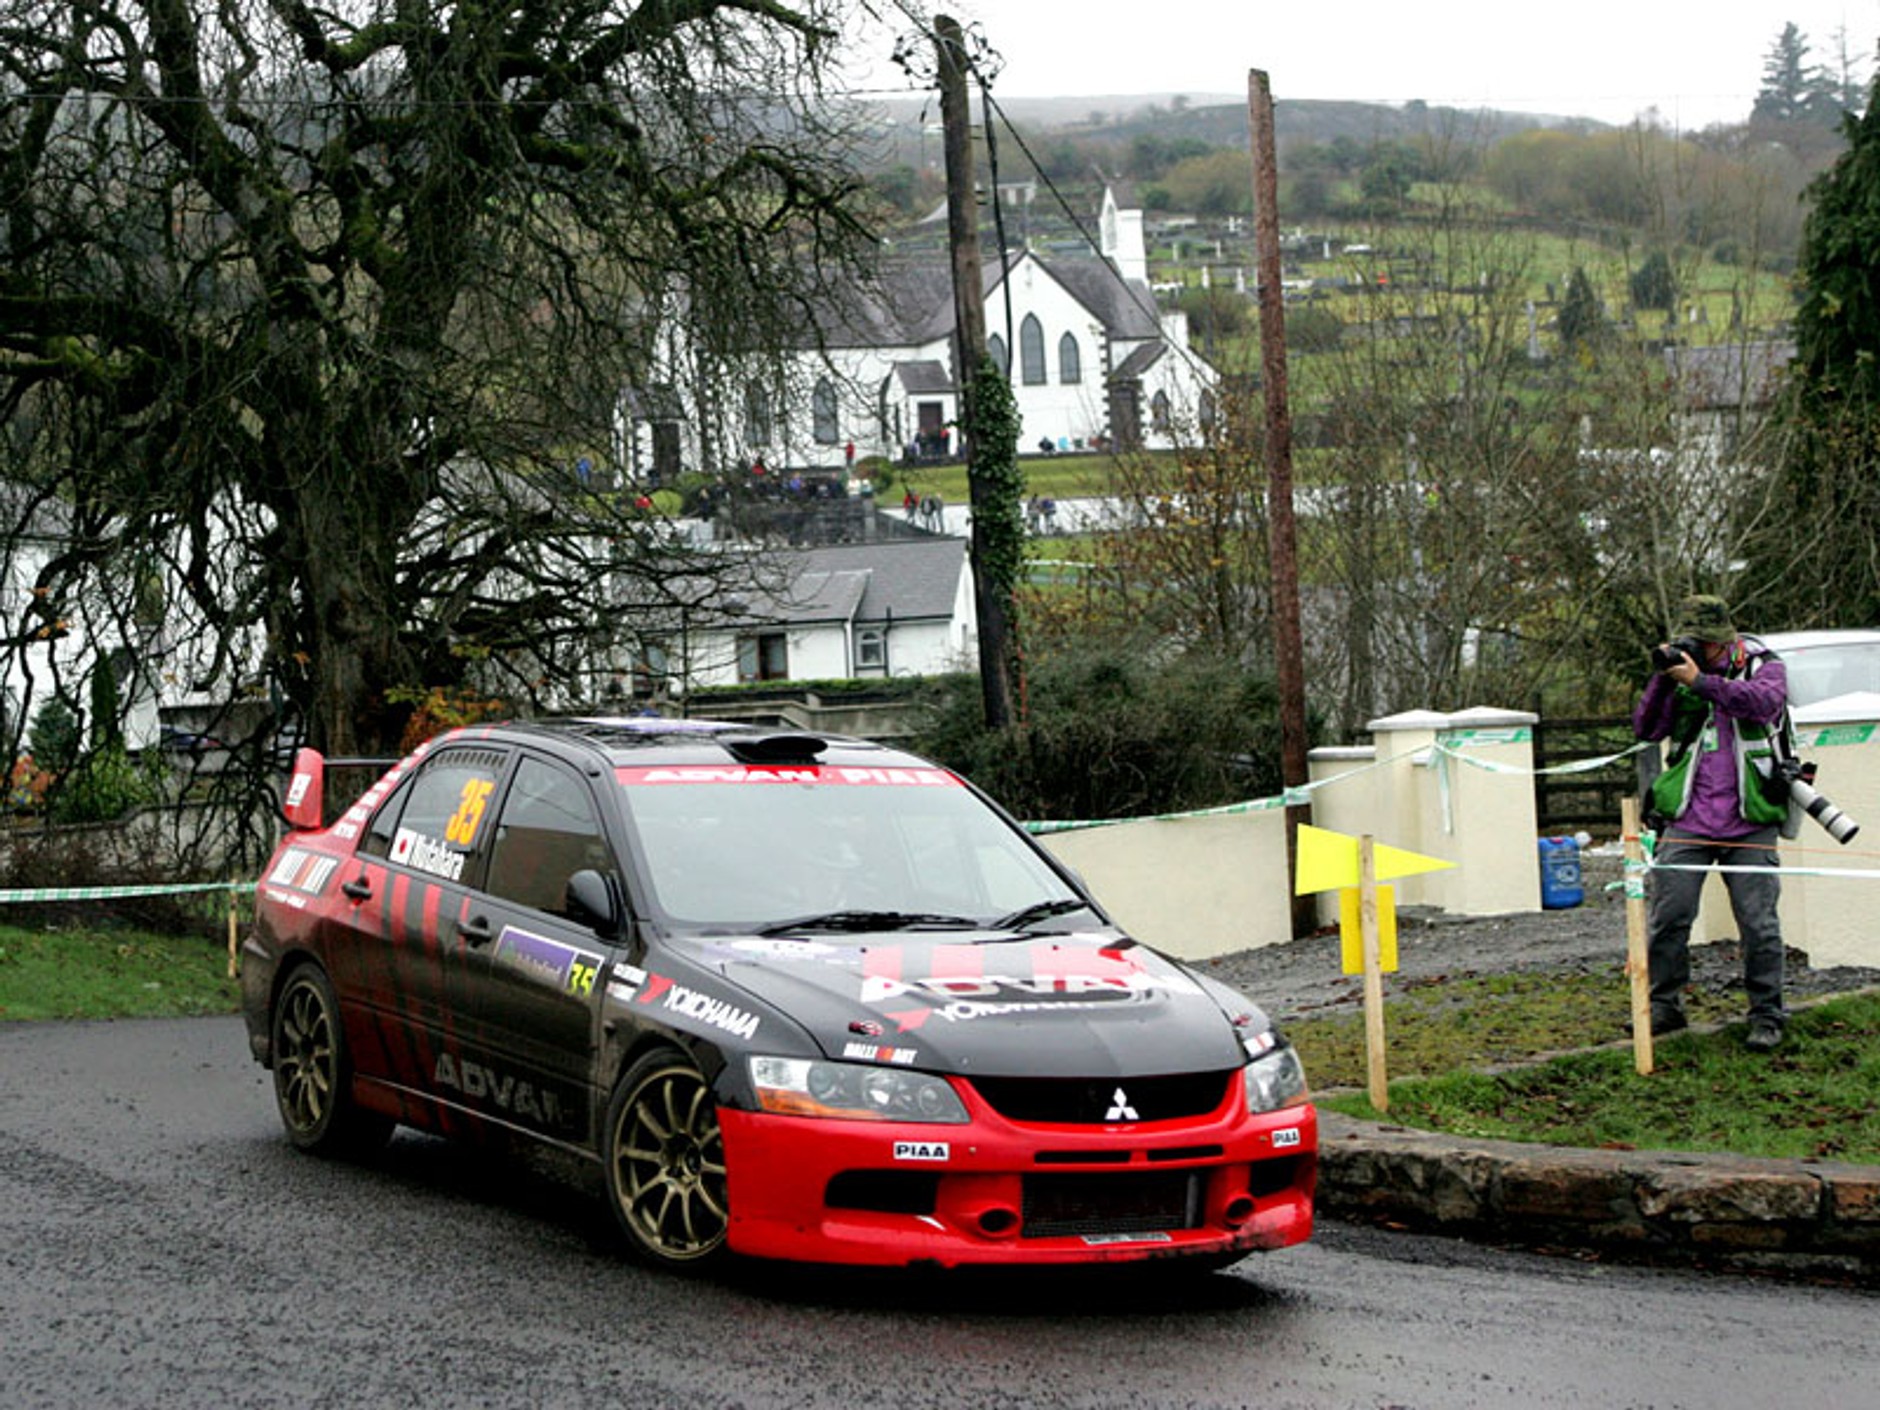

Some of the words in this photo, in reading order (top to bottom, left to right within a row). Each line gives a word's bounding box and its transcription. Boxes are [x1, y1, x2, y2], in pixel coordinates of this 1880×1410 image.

[642, 768, 819, 783] ADVAN
[445, 777, 495, 845] 35
[662, 983, 760, 1040] YOKOHAMA
[896, 1144, 946, 1158] PIAA
